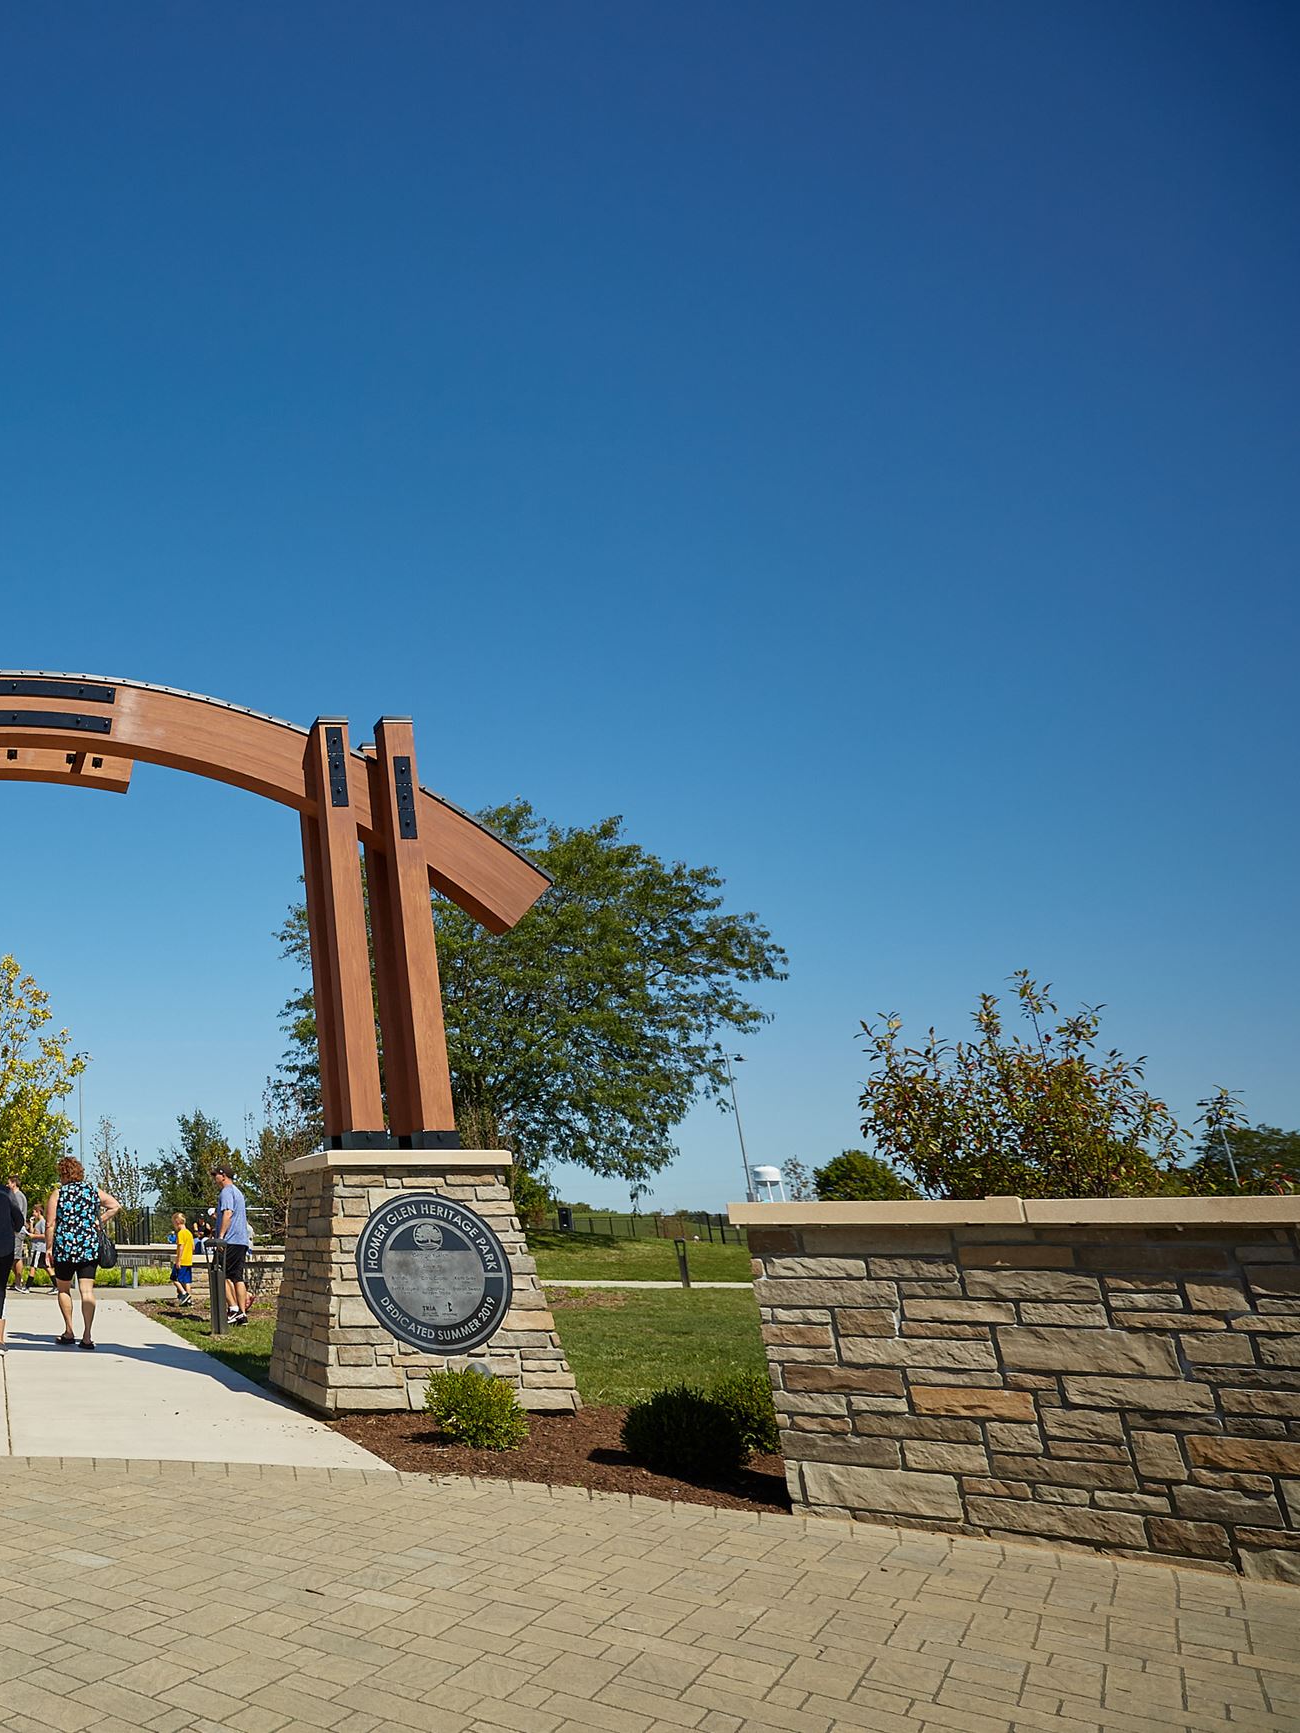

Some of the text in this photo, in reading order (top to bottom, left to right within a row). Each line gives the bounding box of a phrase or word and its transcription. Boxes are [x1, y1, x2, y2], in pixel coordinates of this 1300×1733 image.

[367, 1204, 498, 1271] HOMER GLEN HERITAGE PARK
[380, 1296, 496, 1341] DEDICATED SUMMER 2019
